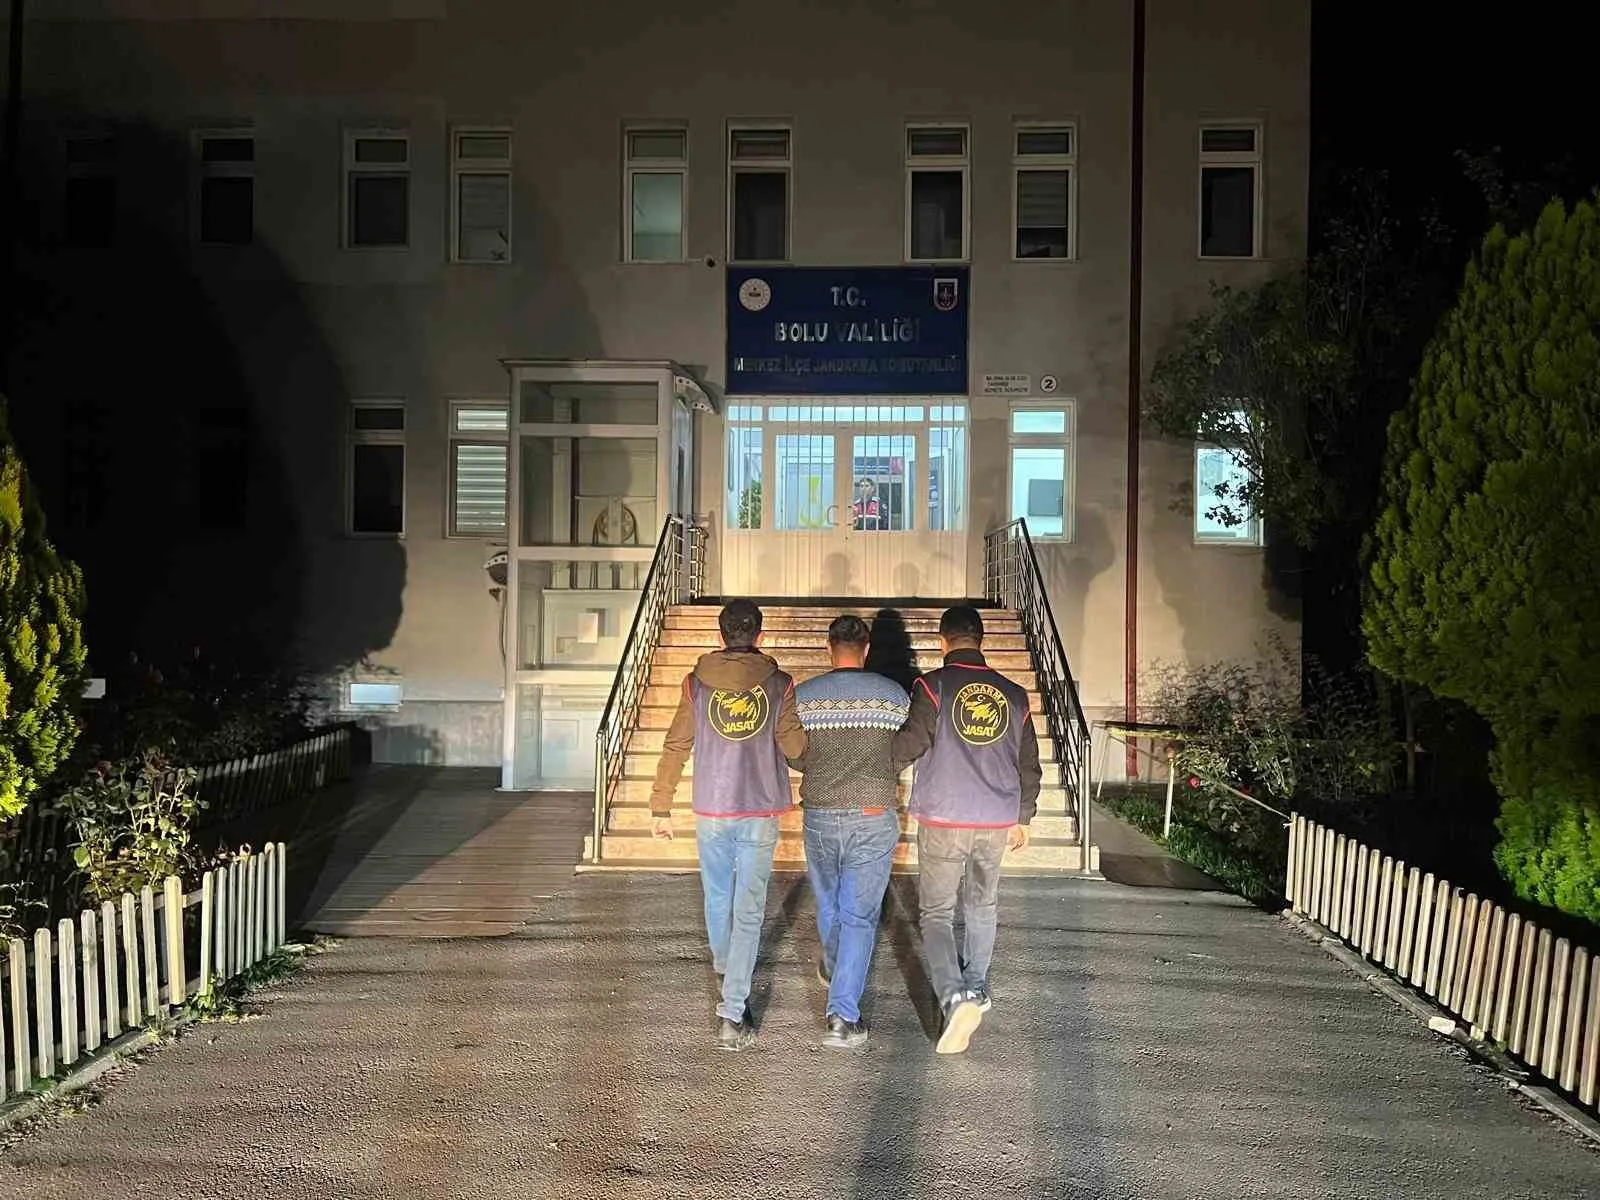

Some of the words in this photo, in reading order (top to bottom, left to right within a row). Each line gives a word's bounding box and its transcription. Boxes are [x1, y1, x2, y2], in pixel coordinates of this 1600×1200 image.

[831, 286, 867, 306] T.C.
[775, 321, 829, 342] BOLU
[784, 353, 811, 375] İLÇE
[1045, 379, 1054, 389] 2
[959, 684, 1008, 708] JANDARMA
[723, 720, 757, 733] JASAT
[963, 724, 997, 737] JASAT
